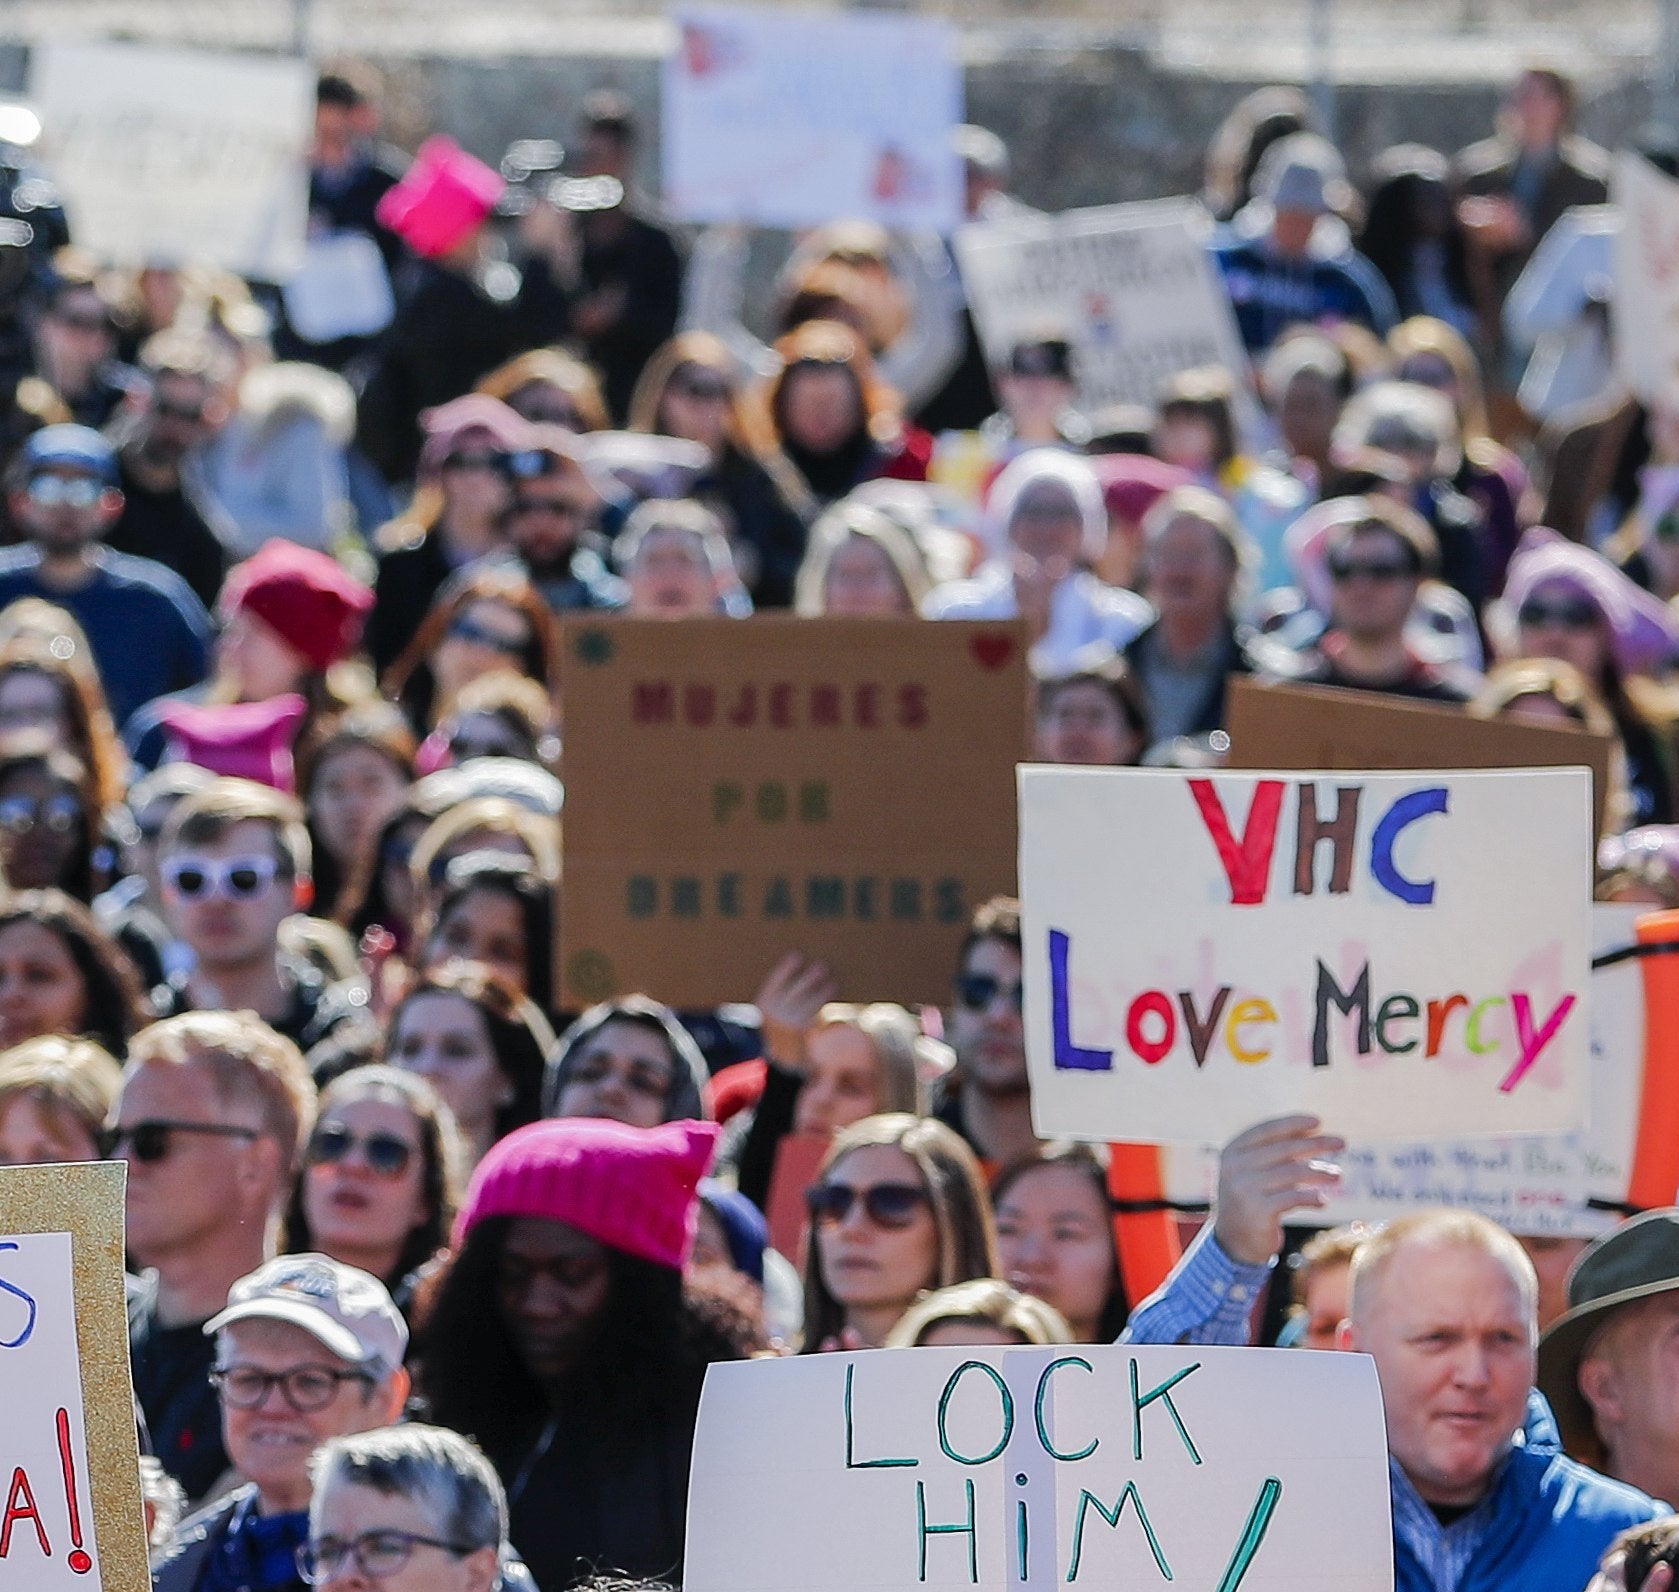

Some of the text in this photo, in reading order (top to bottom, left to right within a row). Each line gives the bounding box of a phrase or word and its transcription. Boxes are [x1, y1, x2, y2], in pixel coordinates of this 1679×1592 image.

[632, 680, 930, 730] MUJERES
[626, 872, 965, 924] DREAMERS
[1186, 776, 1450, 906] VHC
[1047, 928, 1281, 1071] Love
[1310, 956, 1578, 1094] Mercy
[844, 1356, 1206, 1470] LOCK
